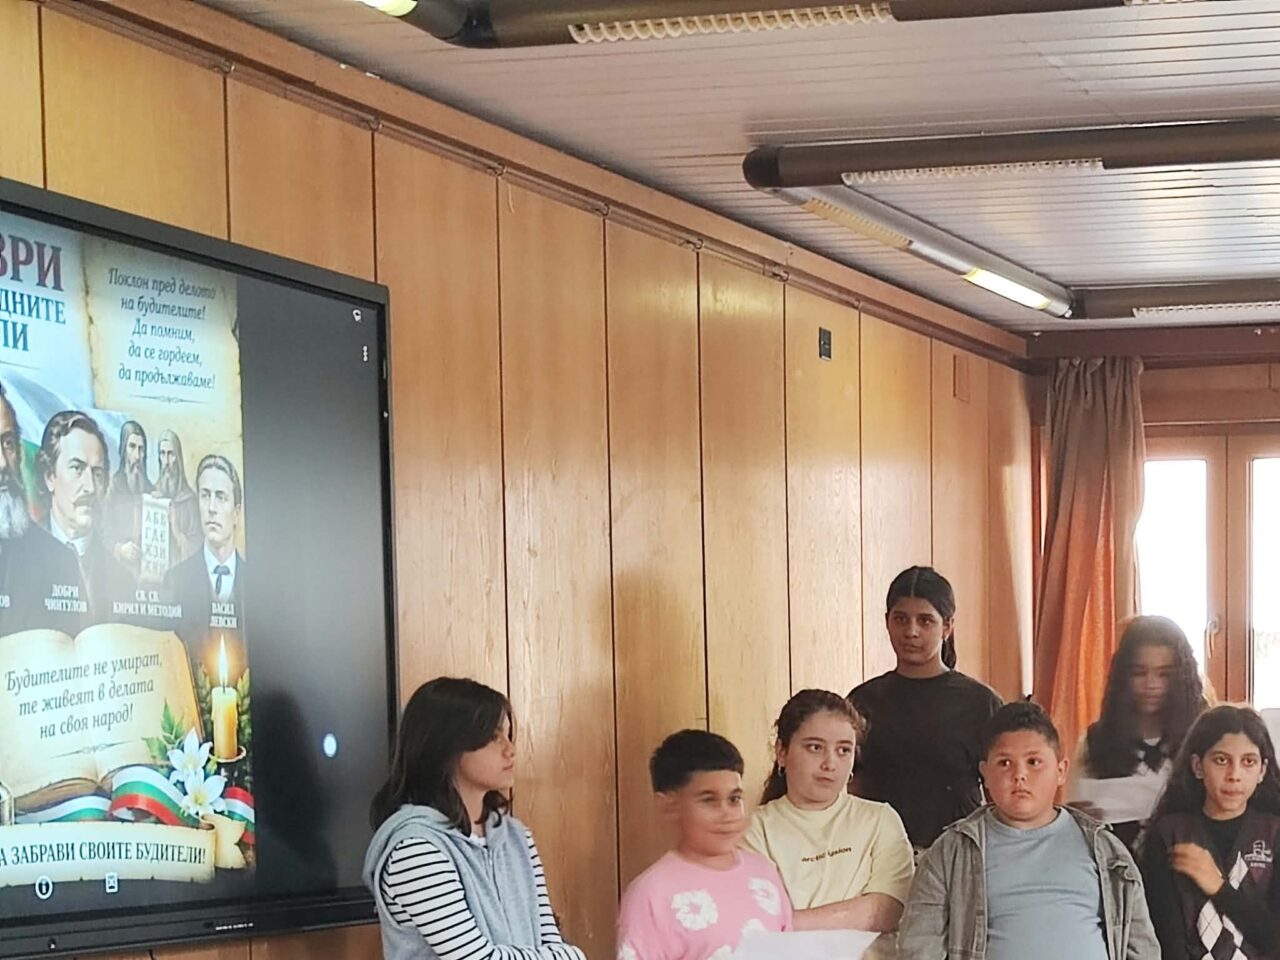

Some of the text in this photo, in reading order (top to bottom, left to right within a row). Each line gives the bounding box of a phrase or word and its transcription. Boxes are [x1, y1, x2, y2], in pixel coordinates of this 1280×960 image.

[108, 267, 216, 300] Поклон пред делото
[121, 295, 206, 320] на будителите!
[132, 318, 195, 344] Да помним,
[128, 340, 202, 366] да се гордеем,
[118, 362, 215, 390] да продължаваме!
[52, 584, 79, 598] ДОБРИ
[44, 598, 88, 613] ЧИНТУЛОВ
[113, 601, 139, 615] КИРИЛ
[147, 603, 182, 618] МЕТОДИЙ
[211, 602, 235, 615] ВАСИЛ
[209, 615, 237, 628] ЛЕВСКИ
[6, 653, 163, 696] Будителите не умират,
[19, 678, 154, 716] те живеят в делата
[40, 703, 134, 739] на своя народ!
[11, 844, 75, 865] ЗАБРАВИ
[79, 842, 132, 862] СВОИТЕ
[135, 842, 206, 865] БУДИТЕЛИ!
